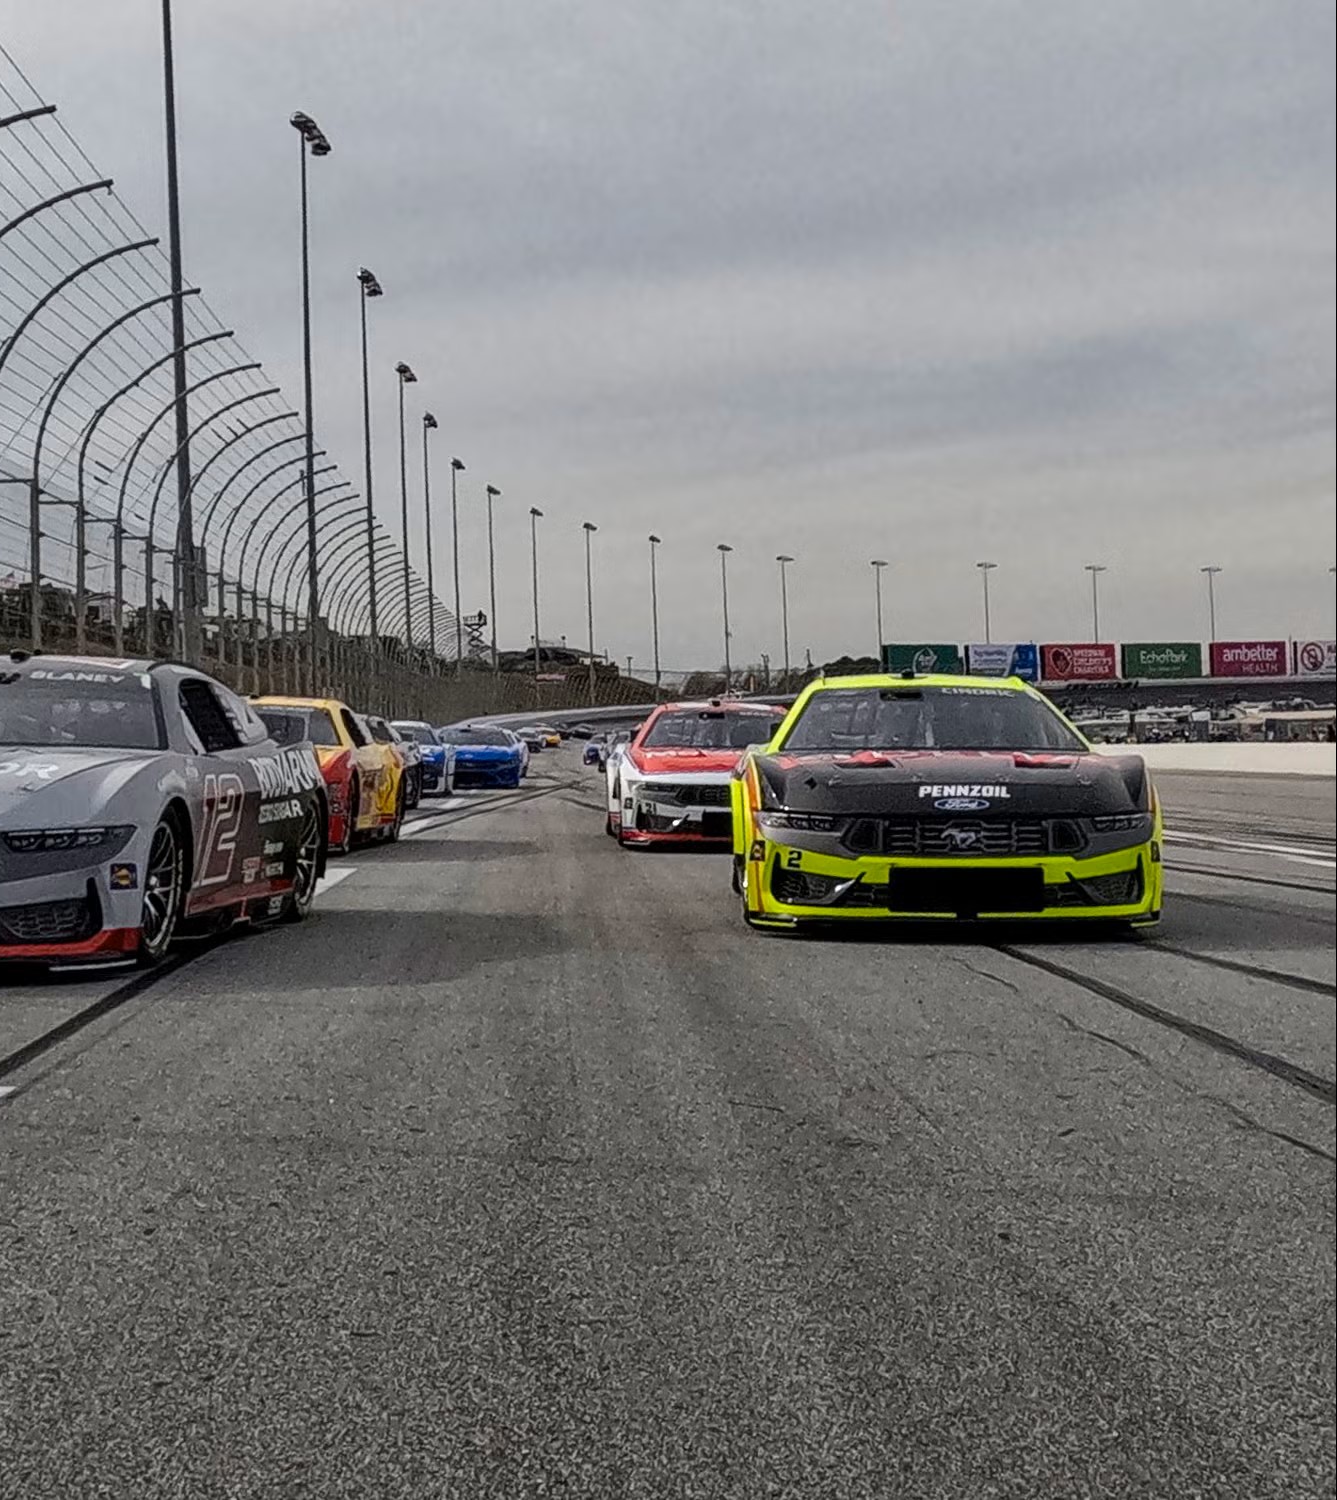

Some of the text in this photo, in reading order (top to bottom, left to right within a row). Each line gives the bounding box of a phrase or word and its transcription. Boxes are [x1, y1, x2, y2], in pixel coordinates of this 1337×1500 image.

[1140, 648, 1188, 664] EchoPark
[1223, 645, 1278, 662] ambetter
[1242, 663, 1279, 673] HEALTH
[30, 670, 125, 683] BLANEY
[941, 687, 1016, 698] CINDRIC
[918, 784, 1011, 798] PENNZOIL
[787, 850, 803, 868] 2
